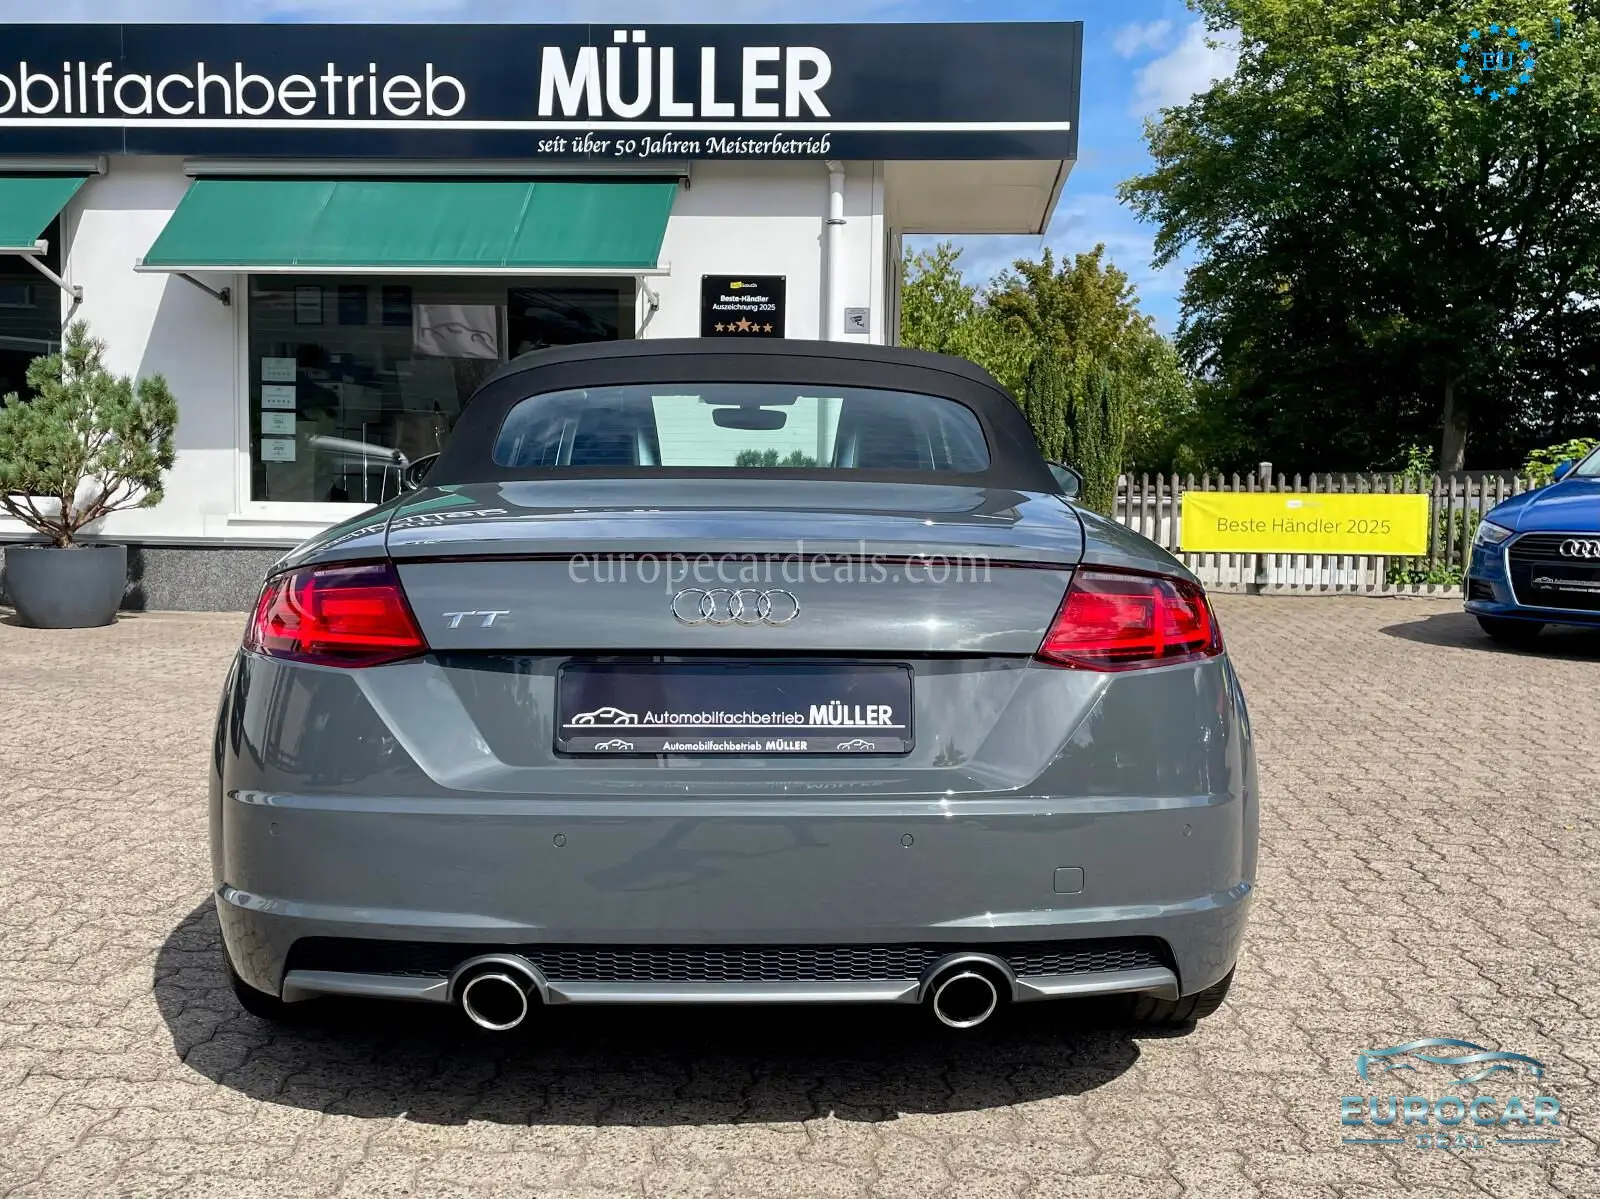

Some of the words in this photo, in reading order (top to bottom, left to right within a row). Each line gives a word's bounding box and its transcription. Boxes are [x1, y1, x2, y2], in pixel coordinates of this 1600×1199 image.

[537, 29, 832, 119] MÜLLER
[537, 135, 567, 153] seit
[571, 132, 611, 153] über
[614, 139, 637, 156] 50
[638, 132, 701, 158] Jahren
[705, 132, 832, 154] Meisterbetrieb
[712, 303, 758, 312] Auszeichnung
[759, 303, 776, 311] 2025
[720, 294, 769, 303] Beste-Händler
[1217, 517, 1266, 533] Beste
[1272, 517, 1342, 534] Händler
[1347, 519, 1391, 535] 2025
[441, 608, 511, 630] TT
[643, 709, 806, 726] Automobilfachbetrieb
[808, 700, 894, 726] MÜLLER
[662, 740, 762, 751] Automobilfachbetrieb
[765, 738, 808, 751] MÜLLER
